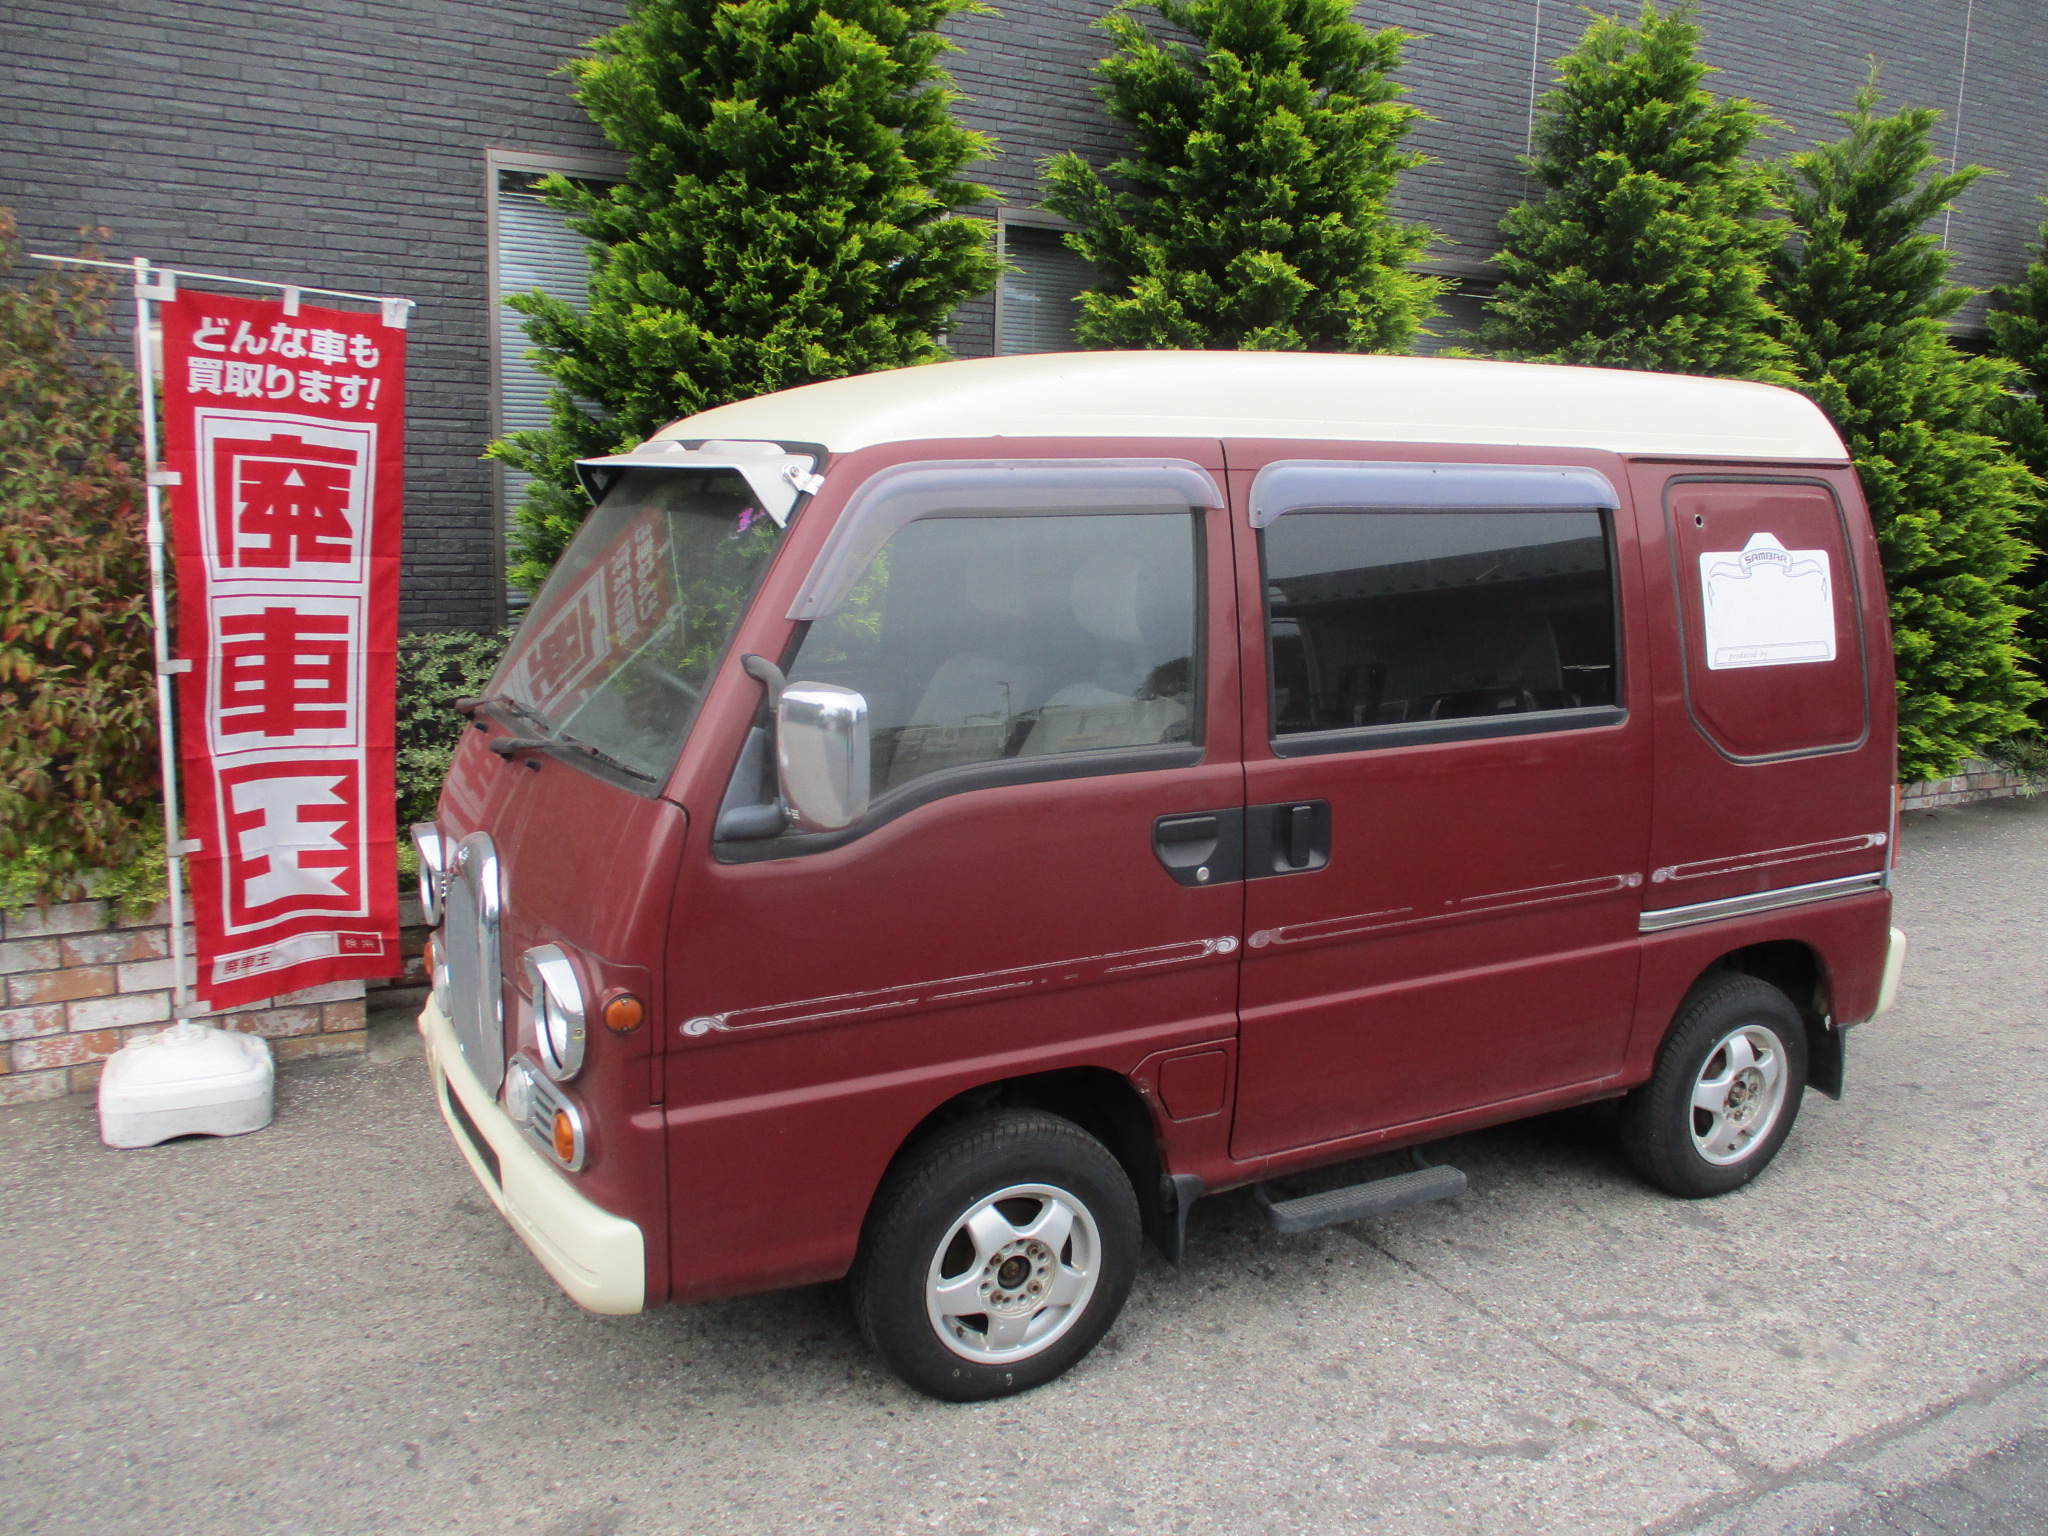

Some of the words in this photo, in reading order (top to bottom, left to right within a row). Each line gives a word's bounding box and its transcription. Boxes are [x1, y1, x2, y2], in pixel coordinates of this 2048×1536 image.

[192, 316, 379, 369] どんな車も
[187, 356, 380, 411] 買取ります!
[1744, 552, 1788, 564] SAMBAR
[212, 433, 358, 909] 廃車王
[1729, 649, 1758, 662] produced
[1760, 649, 1768, 660] by
[224, 950, 272, 975] 廃車王
